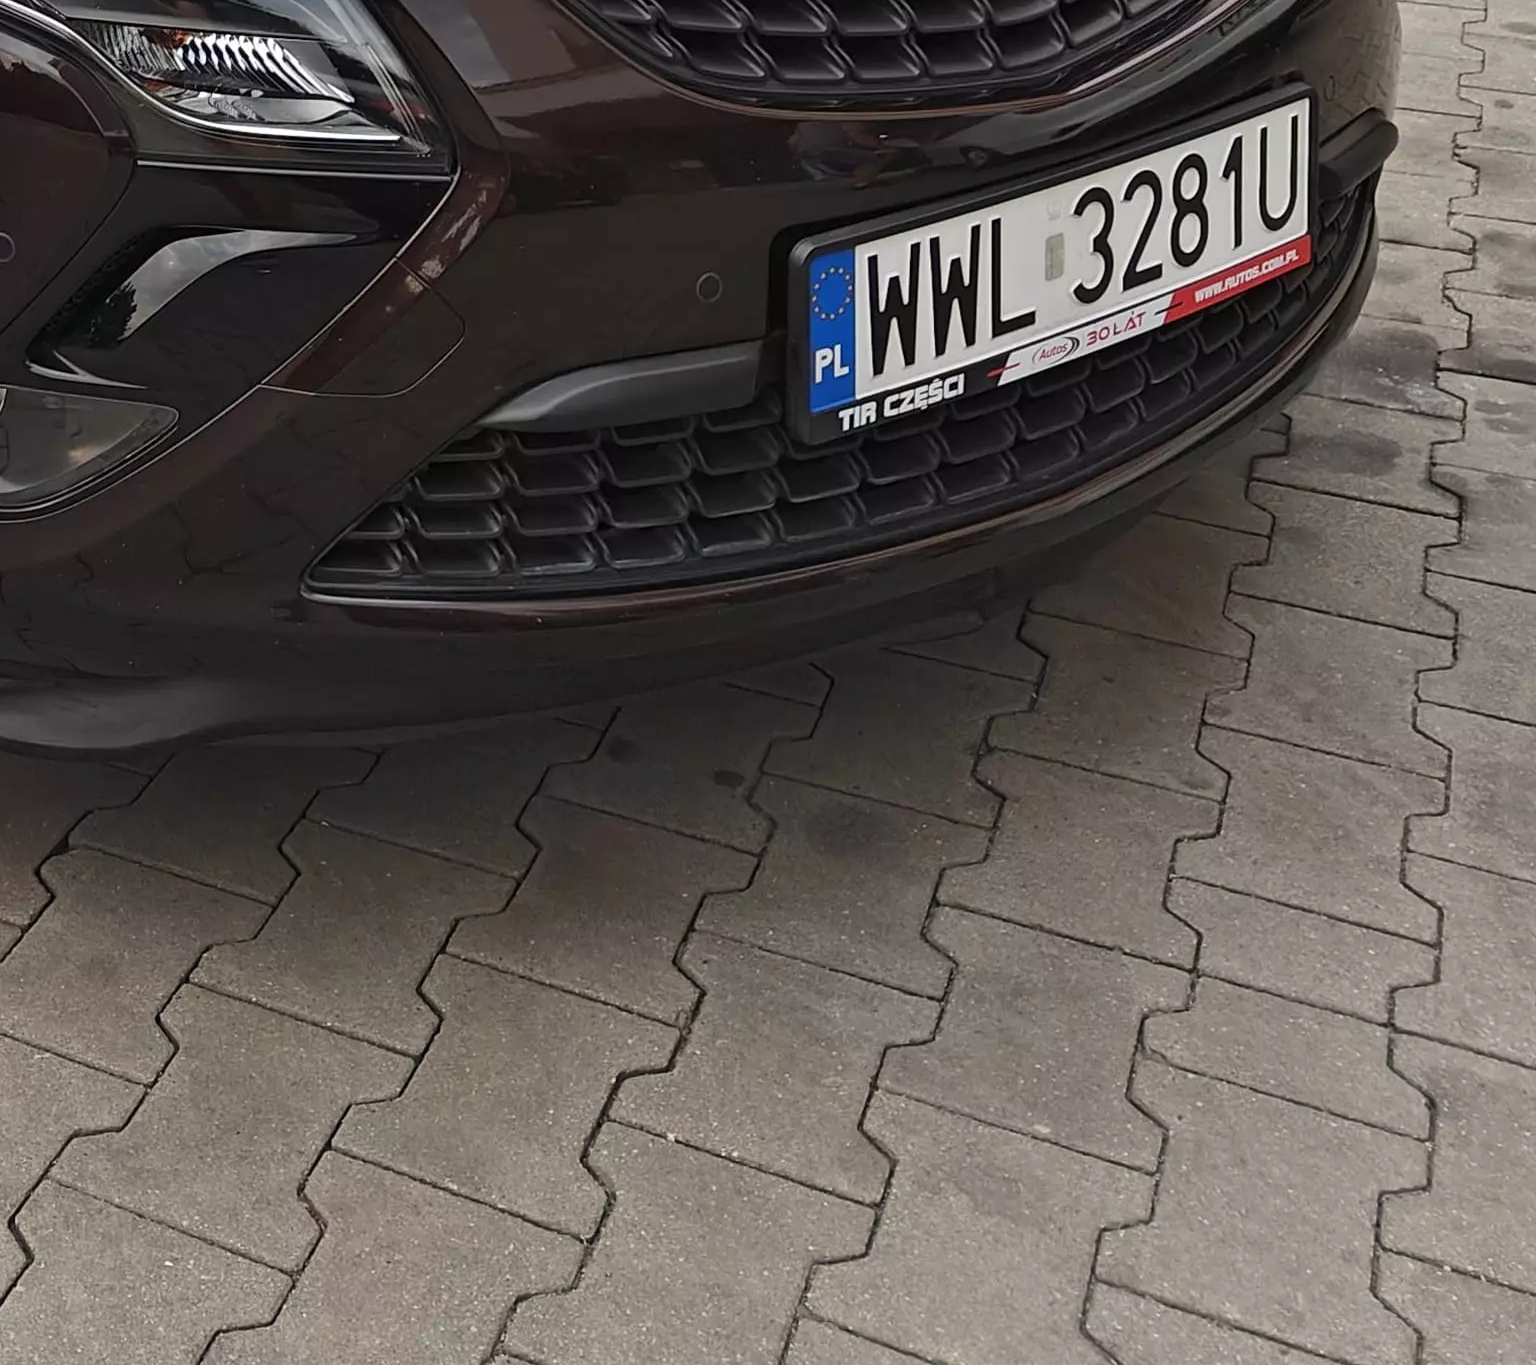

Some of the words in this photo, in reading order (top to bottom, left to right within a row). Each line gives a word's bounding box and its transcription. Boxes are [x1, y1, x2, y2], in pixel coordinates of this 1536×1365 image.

[867, 218, 1036, 377] WWL
[1073, 114, 1299, 304] 3281U
[1194, 249, 1300, 303] WWW.AUTOS.COM.PL
[1038, 343, 1069, 362] Autos
[1086, 326, 1110, 346] 30
[815, 344, 850, 384] PL
[838, 401, 877, 431] TIR
[883, 373, 965, 418] CZĘŚCI
